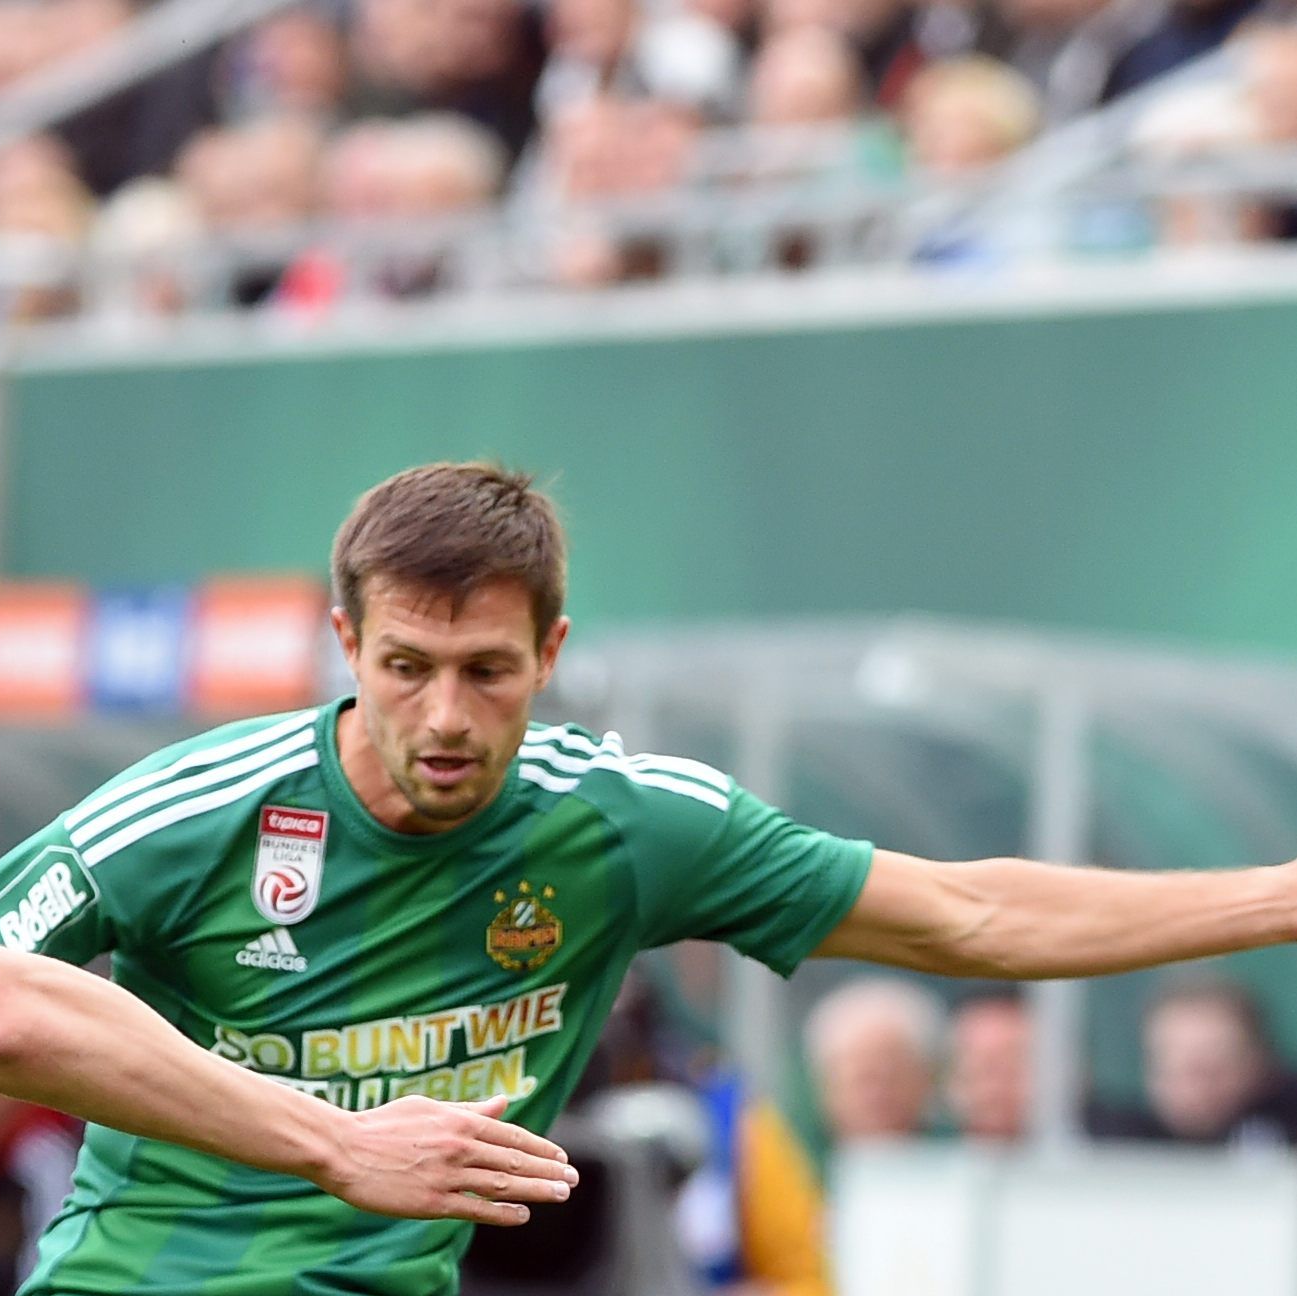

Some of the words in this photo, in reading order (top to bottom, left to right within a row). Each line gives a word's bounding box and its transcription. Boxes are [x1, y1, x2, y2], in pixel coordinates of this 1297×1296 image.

[235, 949, 308, 973] adidas
[304, 1010, 461, 1078] BUNT
[464, 984, 566, 1053] WIE
